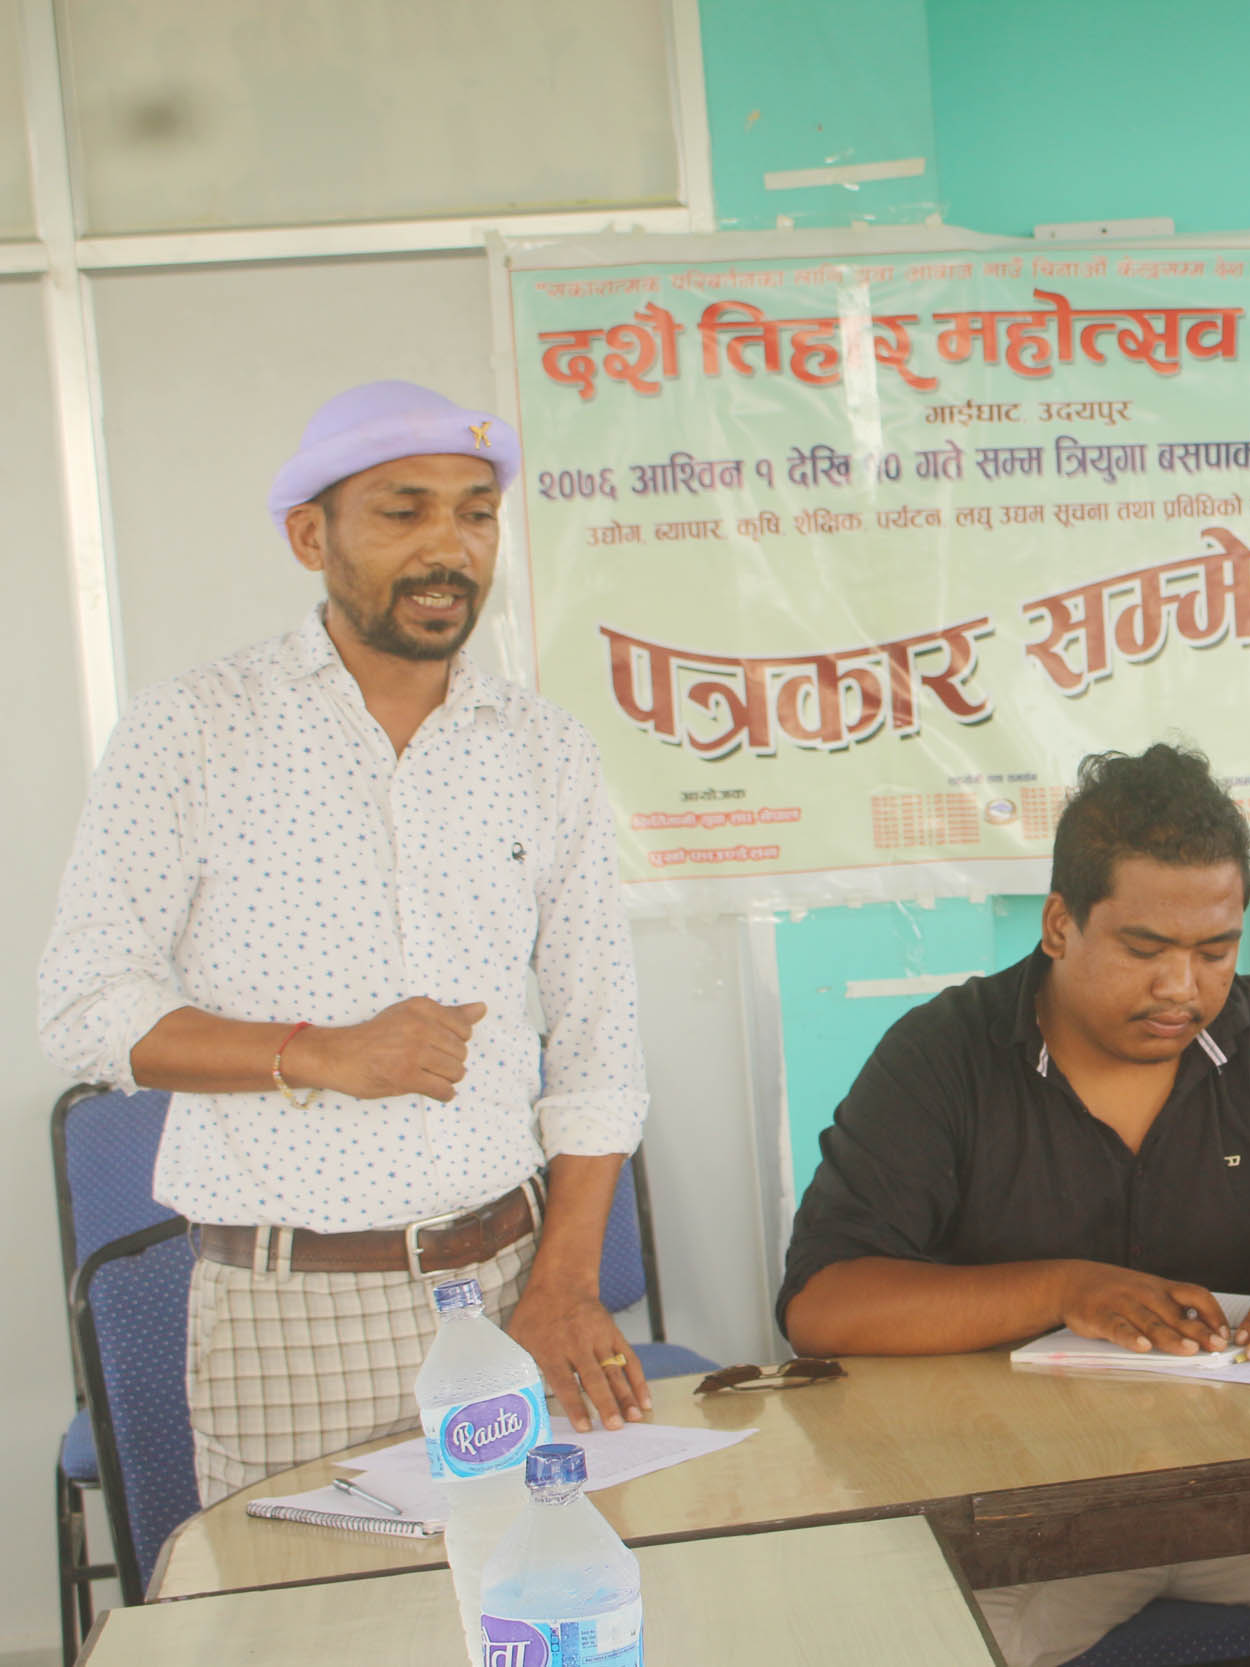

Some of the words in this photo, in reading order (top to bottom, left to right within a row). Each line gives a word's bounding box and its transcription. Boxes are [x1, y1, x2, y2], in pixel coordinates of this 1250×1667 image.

[932, 288, 1244, 376] महोत्सव
[1037, 401, 1133, 426] उदयपुर
[538, 468, 618, 502] २०७६
[628, 450, 745, 496] आश्विन
[755, 457, 776, 490] १
[786, 446, 852, 488] देखि
[915, 439, 964, 482] गते
[975, 446, 1044, 484] सम्म
[1054, 434, 1149, 485] त्रियुगा
[1116, 501, 1155, 522] तथा
[598, 615, 993, 755] पत्रकार
[453, 1407, 523, 1456] Rauta
